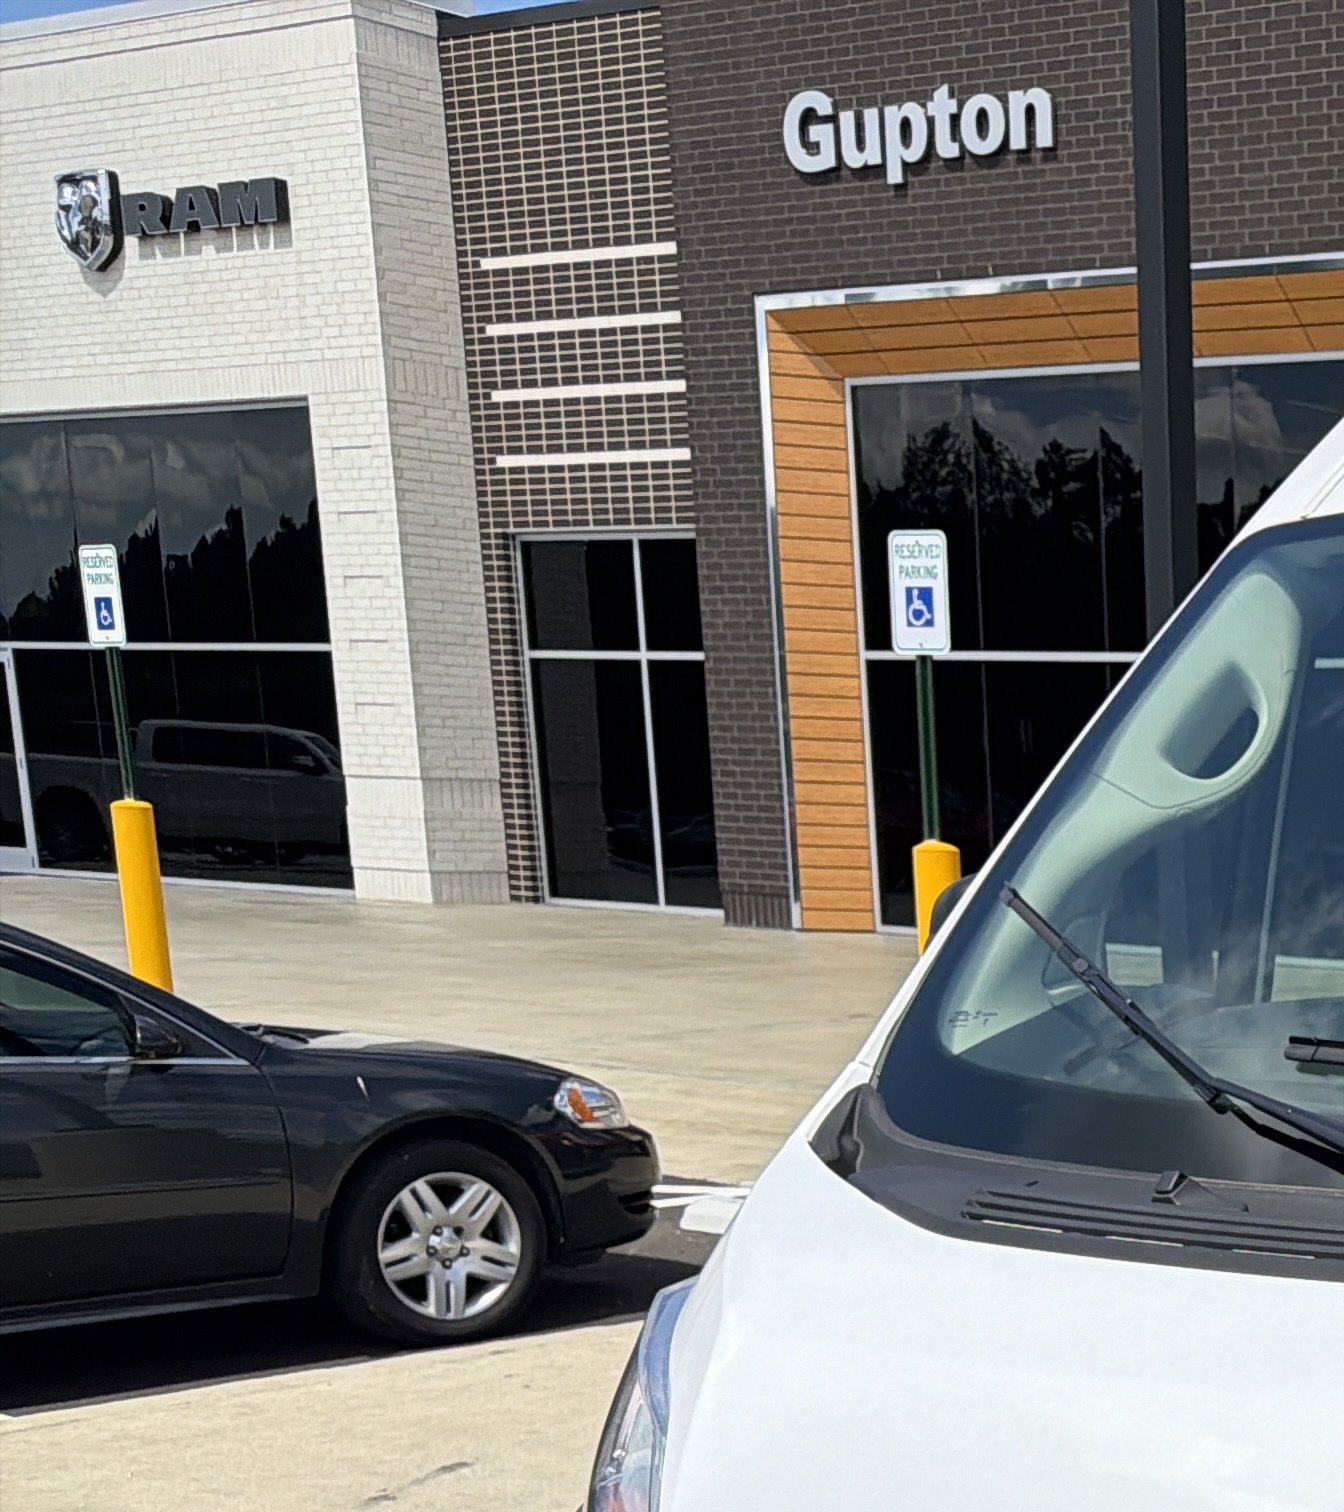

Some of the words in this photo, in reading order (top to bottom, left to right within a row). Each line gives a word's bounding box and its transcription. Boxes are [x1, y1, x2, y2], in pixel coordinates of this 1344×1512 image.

[783, 83, 1054, 184] Gupton
[120, 177, 287, 236] RAM
[894, 544, 941, 559] RESERVED
[899, 564, 938, 580] PARKING
